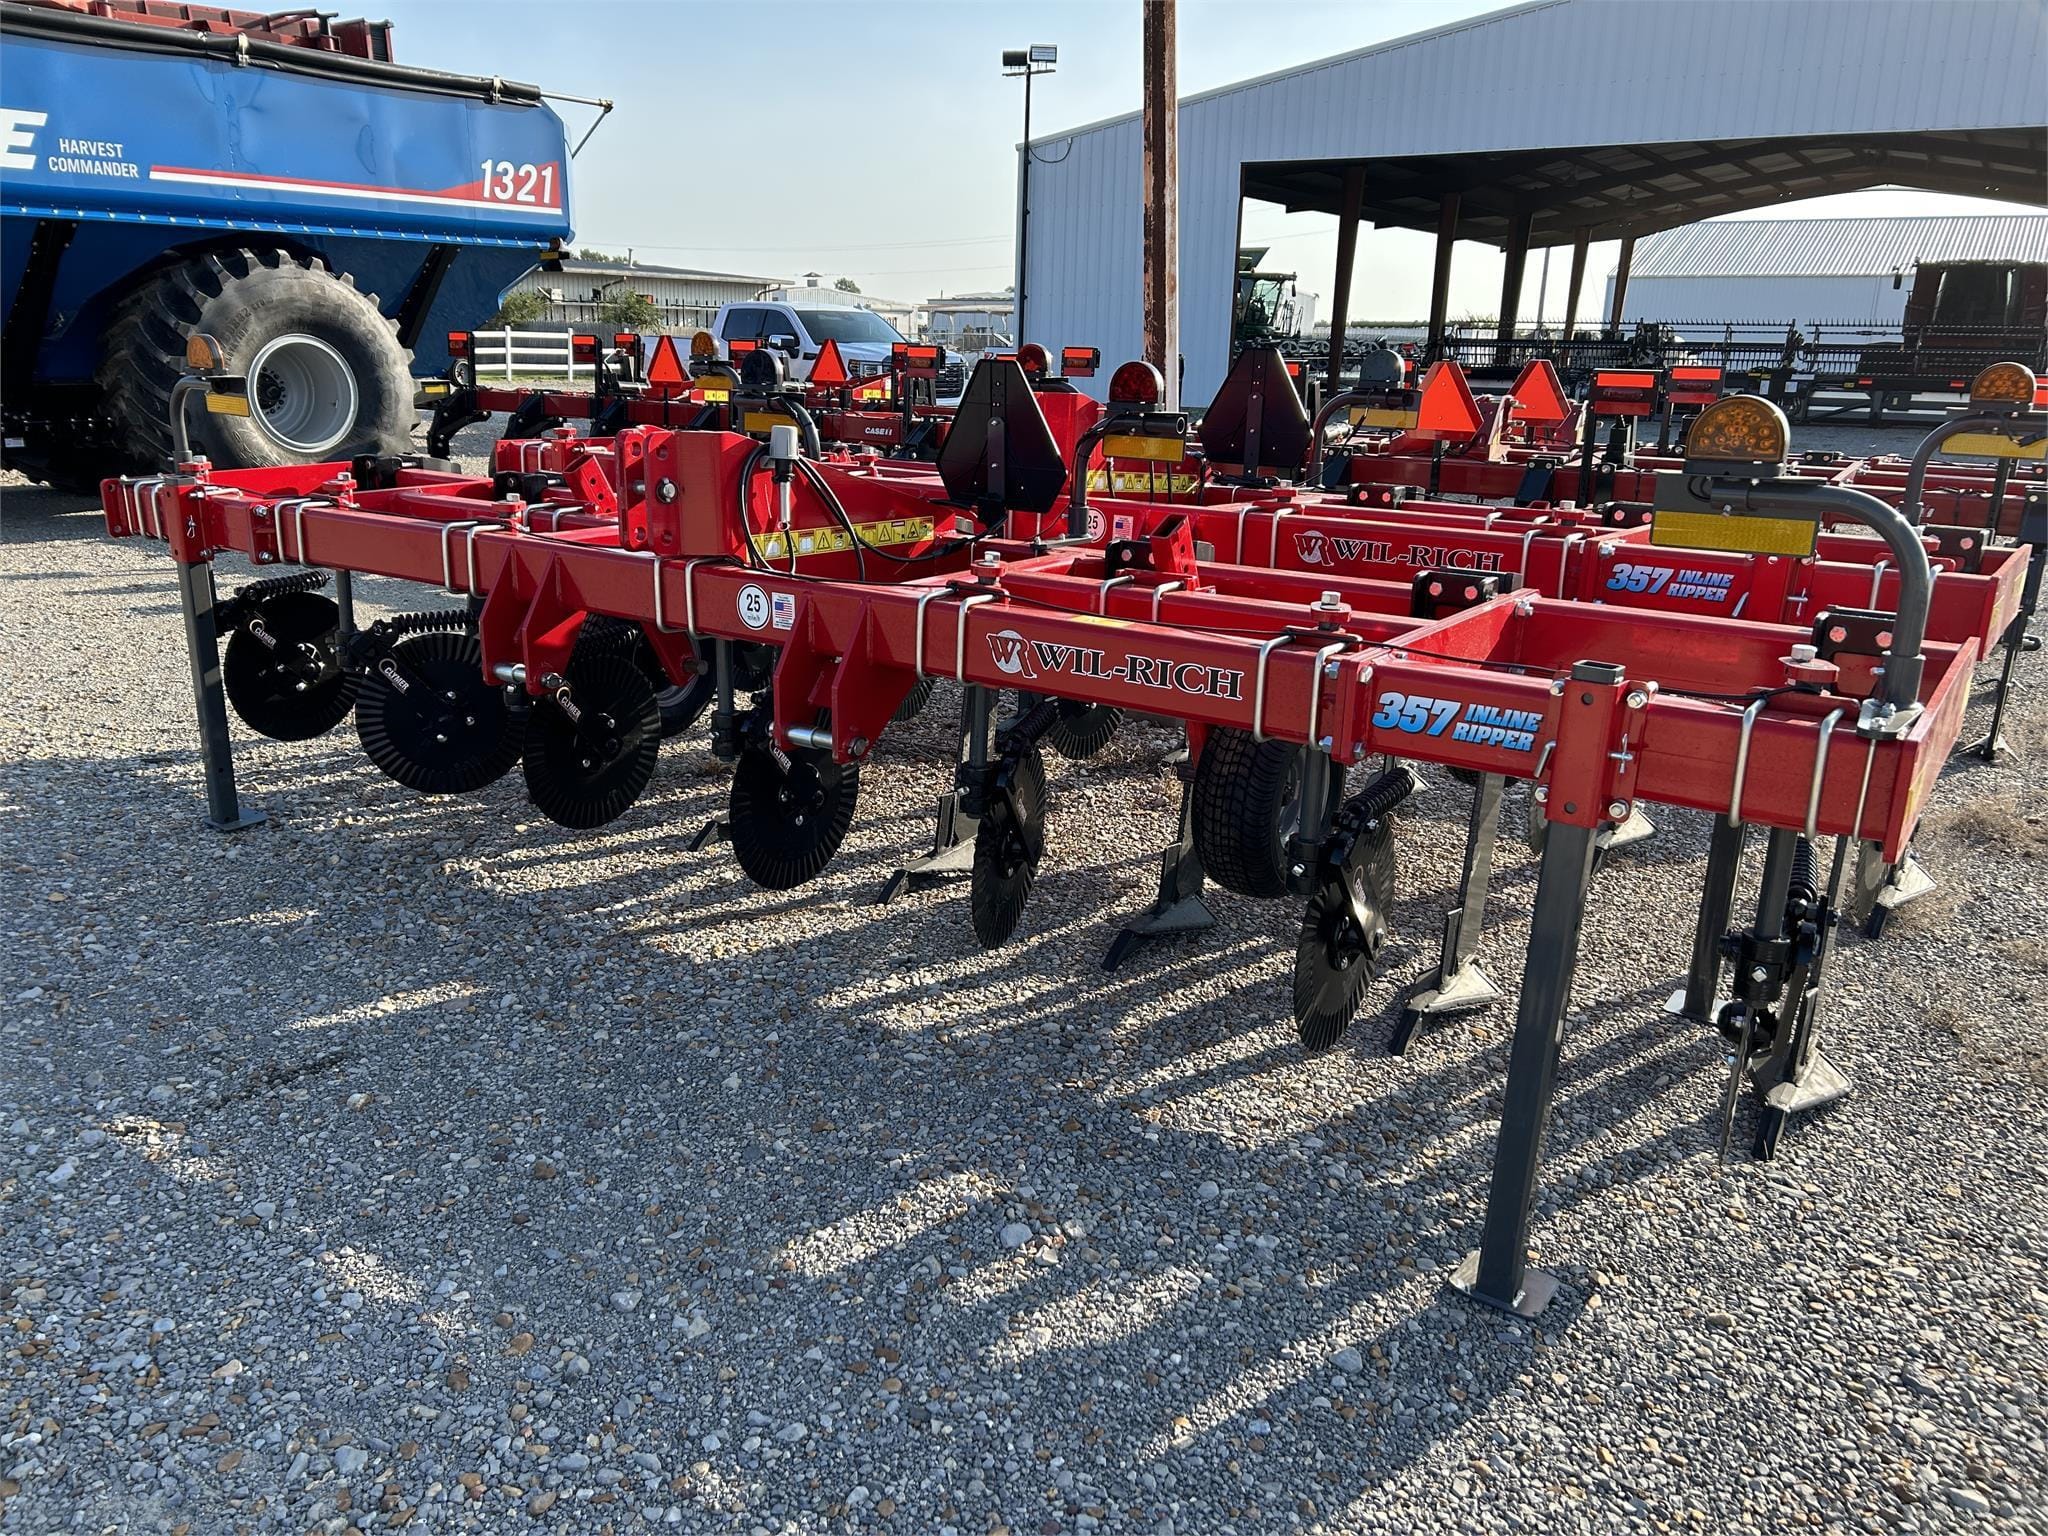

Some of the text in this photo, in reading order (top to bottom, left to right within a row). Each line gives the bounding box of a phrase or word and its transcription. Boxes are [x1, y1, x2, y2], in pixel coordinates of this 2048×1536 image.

[58, 138, 124, 158] HARVEST
[48, 157, 139, 178] COMMANDER
[481, 159, 553, 203] 1321
[1331, 538, 1504, 572] WIL-RICH
[1606, 563, 1675, 594] 357
[1666, 583, 1728, 601] RIPPER
[1676, 569, 1735, 587] INLINE
[746, 593, 761, 612] 25
[1031, 640, 1244, 700] WIL-RICH
[1372, 692, 1462, 737] 357
[1464, 703, 1544, 732] INLINE
[1451, 722, 1535, 751] RIPPER
